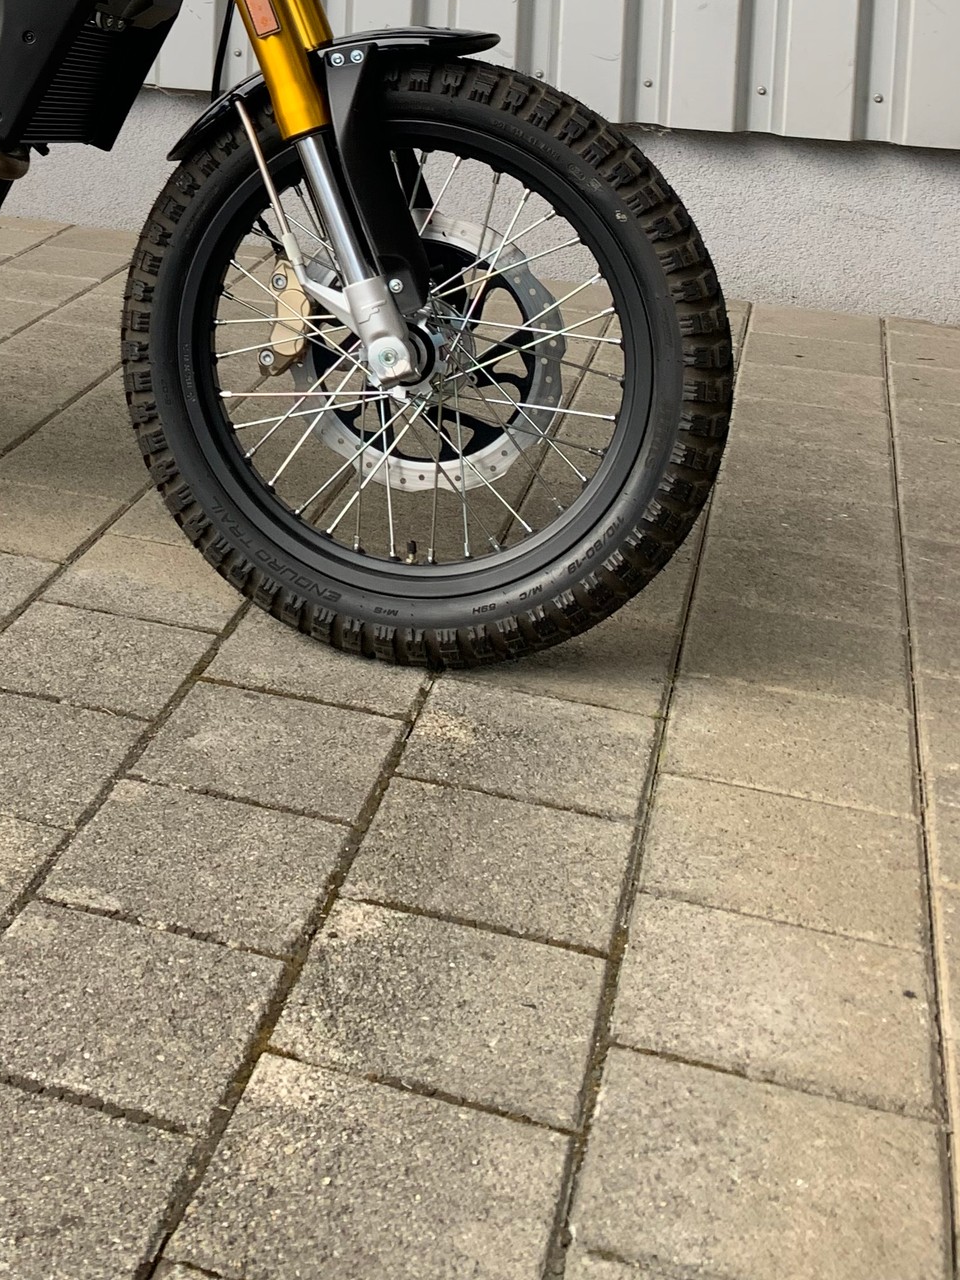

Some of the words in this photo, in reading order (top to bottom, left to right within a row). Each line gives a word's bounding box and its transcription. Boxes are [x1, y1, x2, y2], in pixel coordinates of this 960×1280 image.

[212, 495, 254, 549] TRAIL
[255, 549, 342, 603] ENDURO
[519, 584, 543, 601] M/C
[472, 603, 497, 615] 59H
